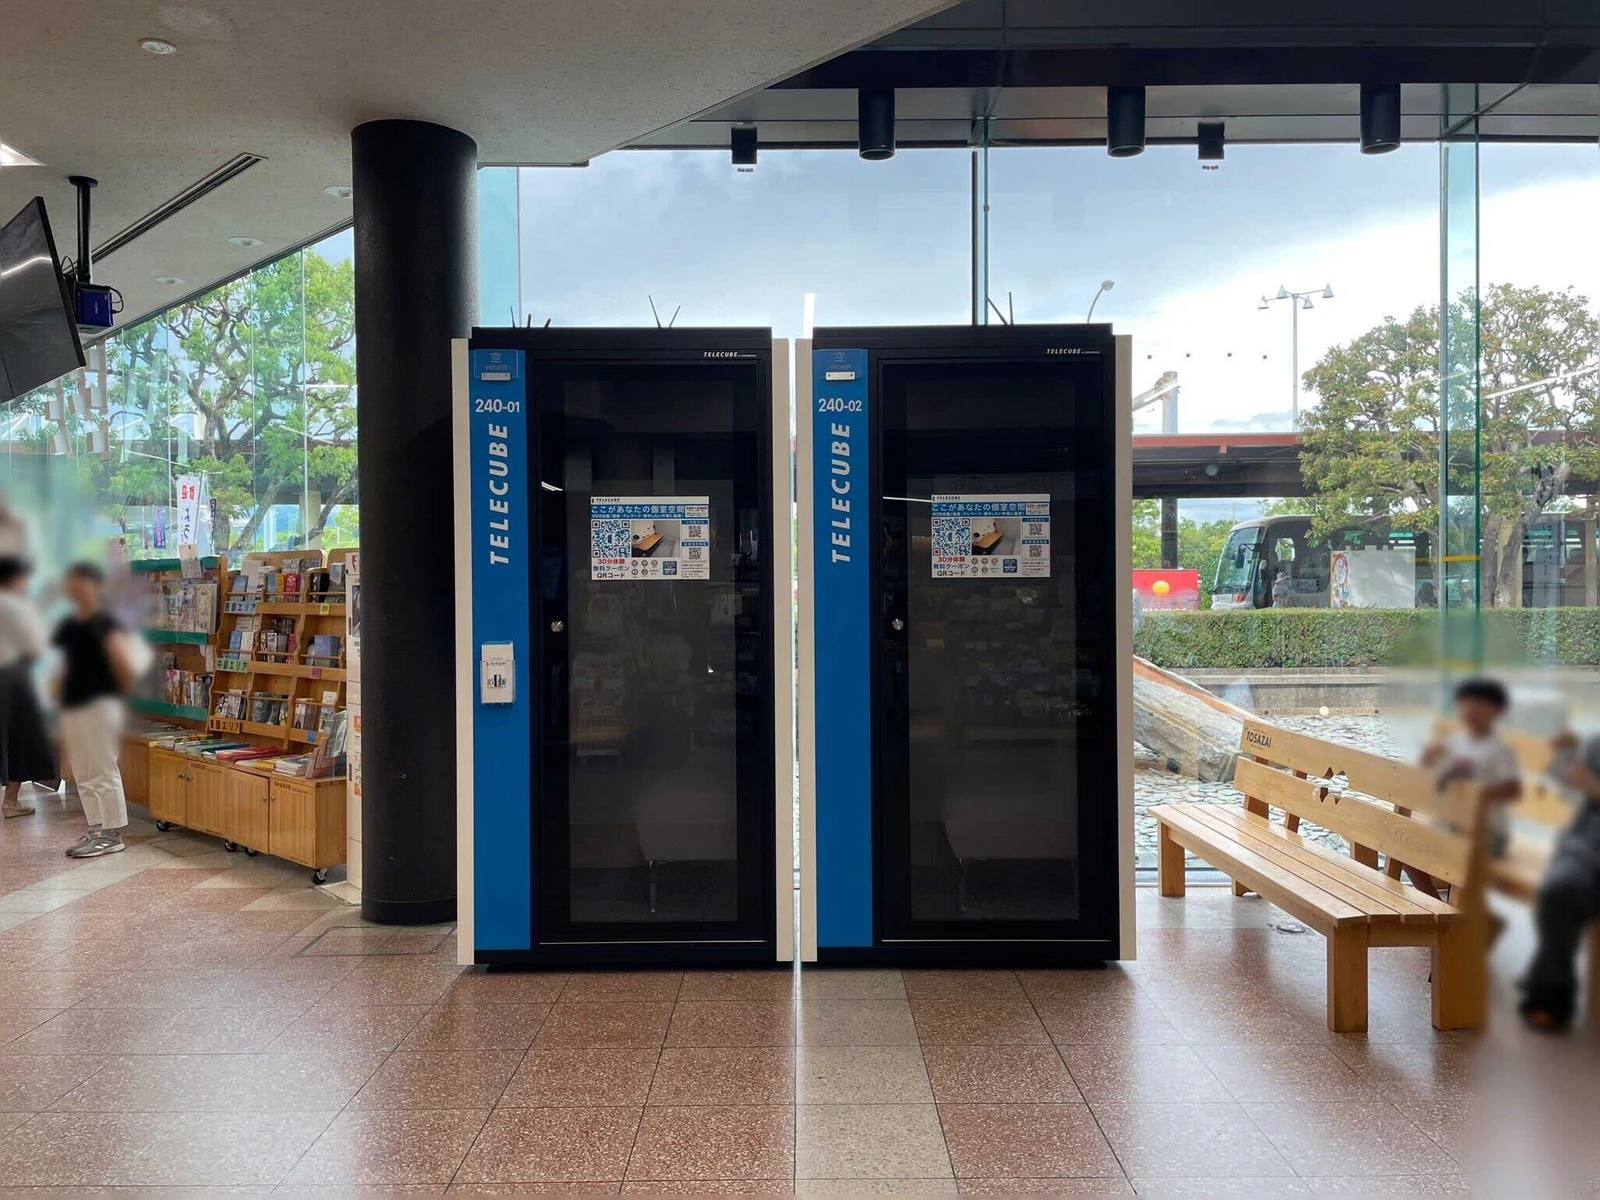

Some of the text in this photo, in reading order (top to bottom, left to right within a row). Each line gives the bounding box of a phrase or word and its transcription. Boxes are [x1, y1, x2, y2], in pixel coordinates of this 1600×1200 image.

[475, 398, 520, 413] 240-01
[818, 398, 862, 413] 240-02
[489, 423, 509, 565] TELECUBE
[831, 422, 851, 563] TELECUBE
[591, 505, 685, 514] ここがあなたの個室空間
[932, 503, 1026, 512] ここがあなたの個室空間
[1246, 731, 1272, 748] TOSAZAI
